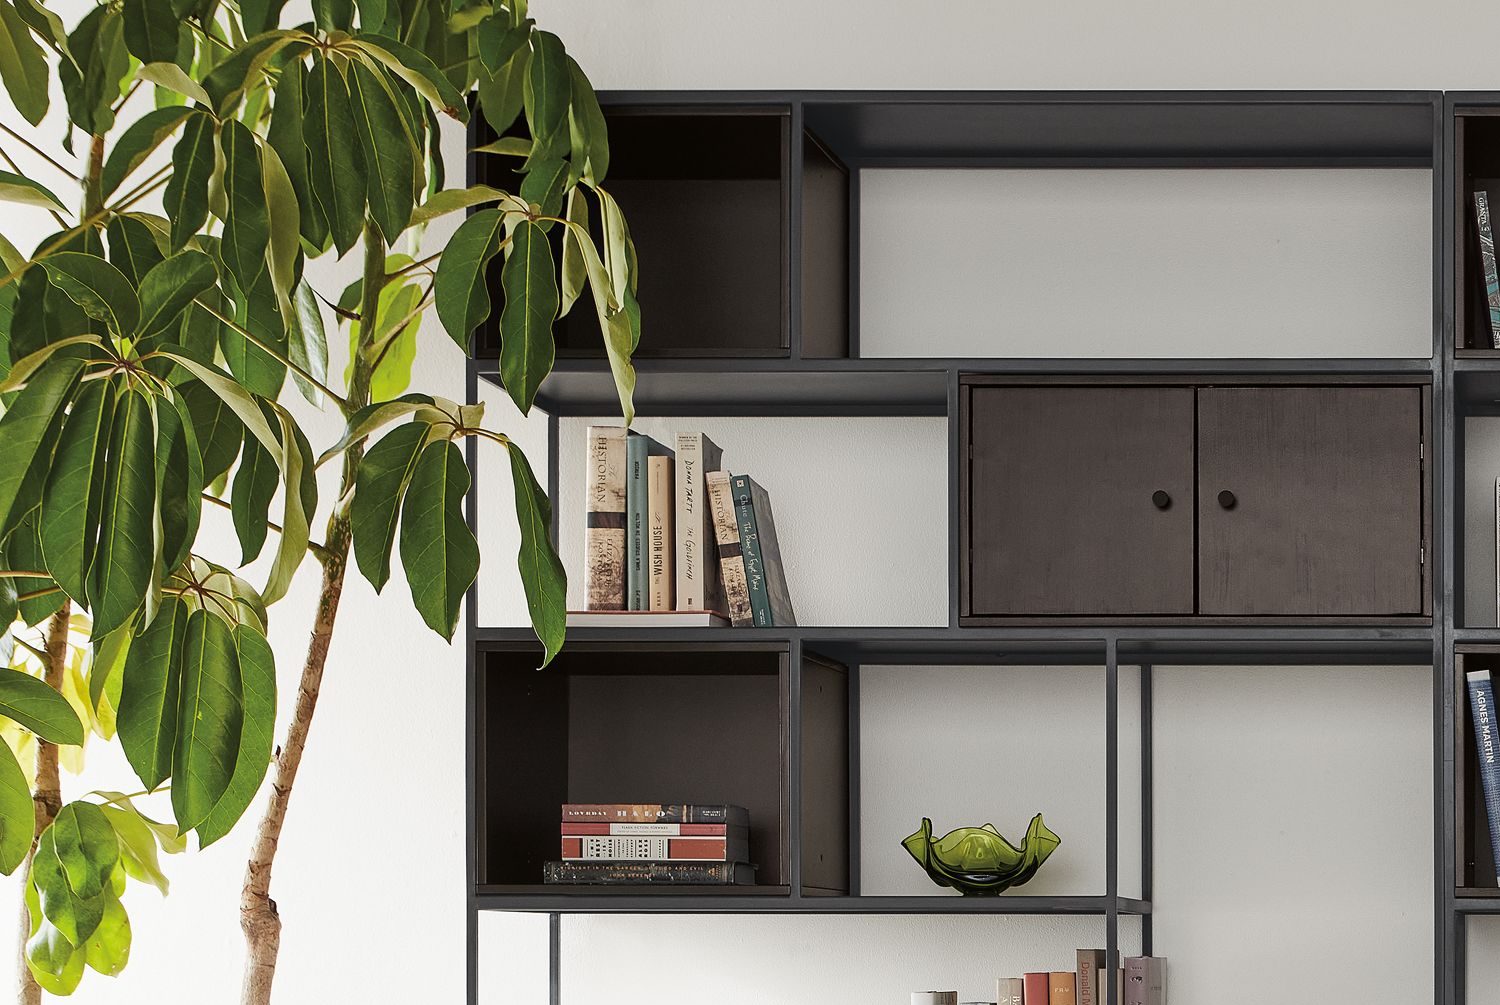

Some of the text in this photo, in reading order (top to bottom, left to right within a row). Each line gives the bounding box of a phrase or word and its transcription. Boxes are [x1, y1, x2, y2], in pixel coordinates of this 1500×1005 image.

[1478, 198, 1488, 224] GRANTA
[598, 437, 607, 503] HISTORIAN
[714, 490, 728, 540] HISTORIAN
[654, 526, 662, 552] HOUSE
[654, 555, 662, 575] WISH
[1476, 690, 1495, 763] AGNES MARTIN
[1081, 962, 1091, 995] Donald
